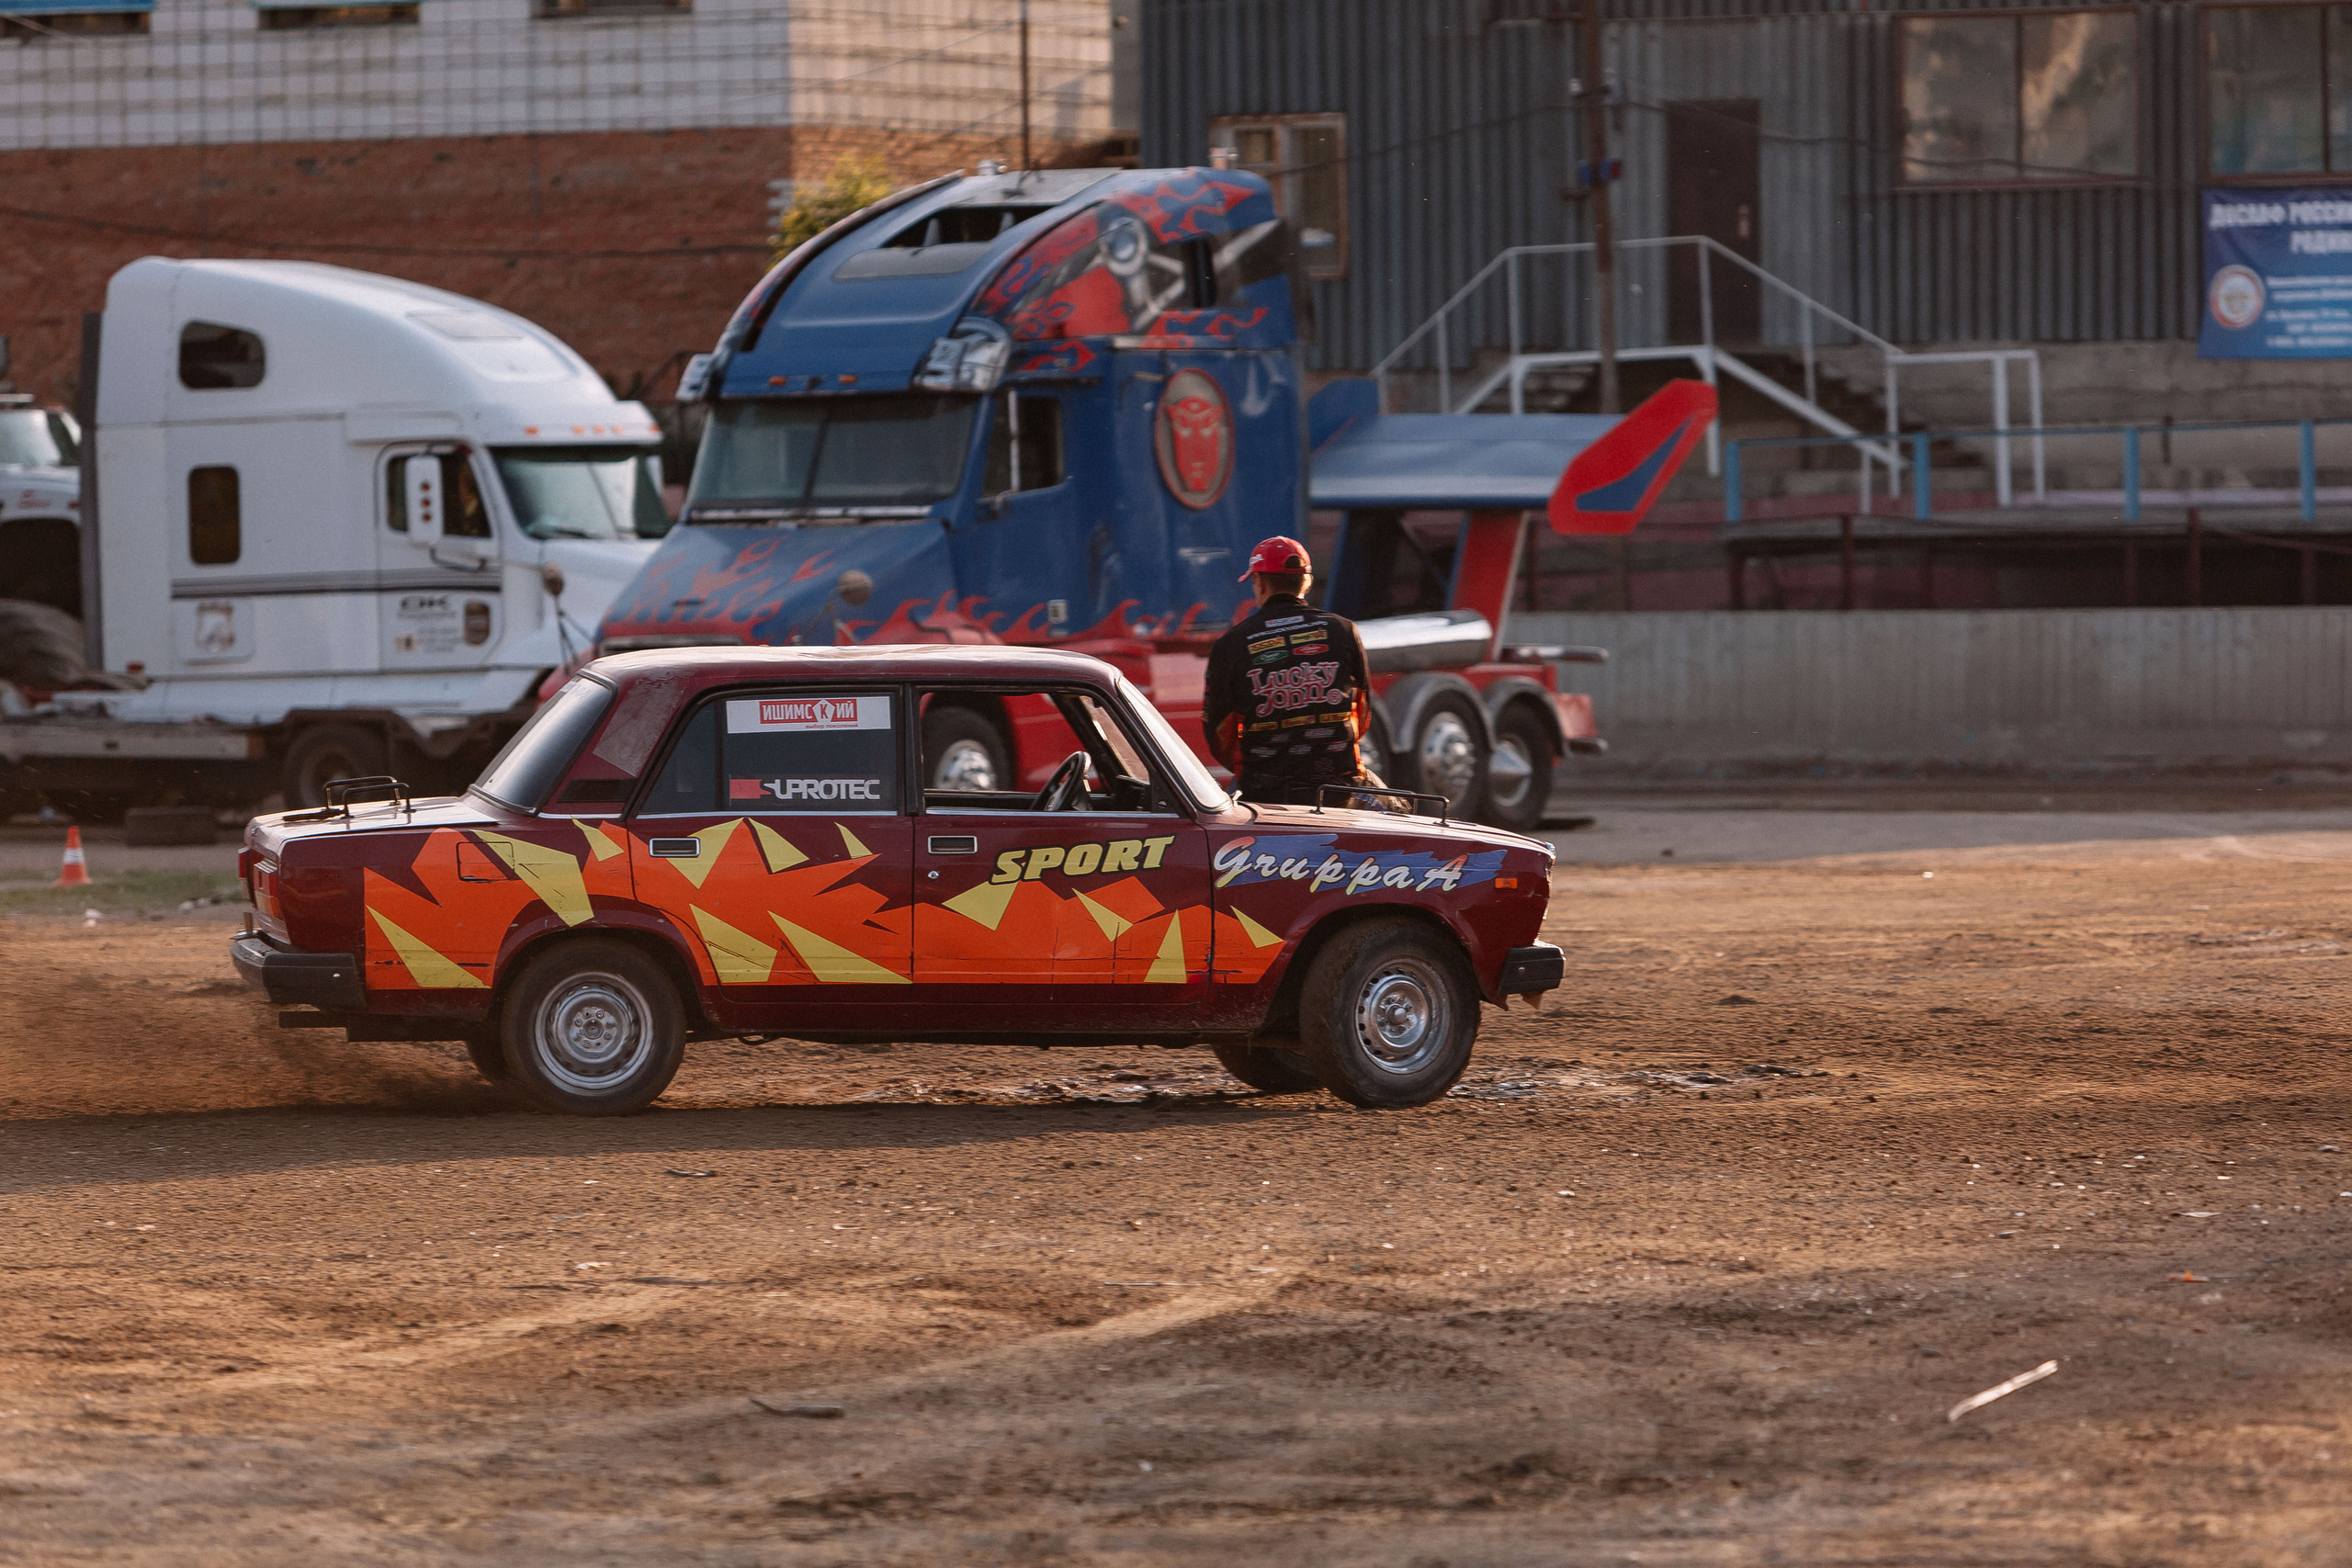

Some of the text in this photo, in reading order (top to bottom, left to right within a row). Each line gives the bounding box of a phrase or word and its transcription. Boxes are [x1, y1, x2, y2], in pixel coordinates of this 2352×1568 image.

[1246, 661, 1340, 694] Lucky
[762, 700, 855, 721] ИШИМСКИЙ
[1256, 682, 1327, 717] John
[989, 834, 1177, 885] SPORT
